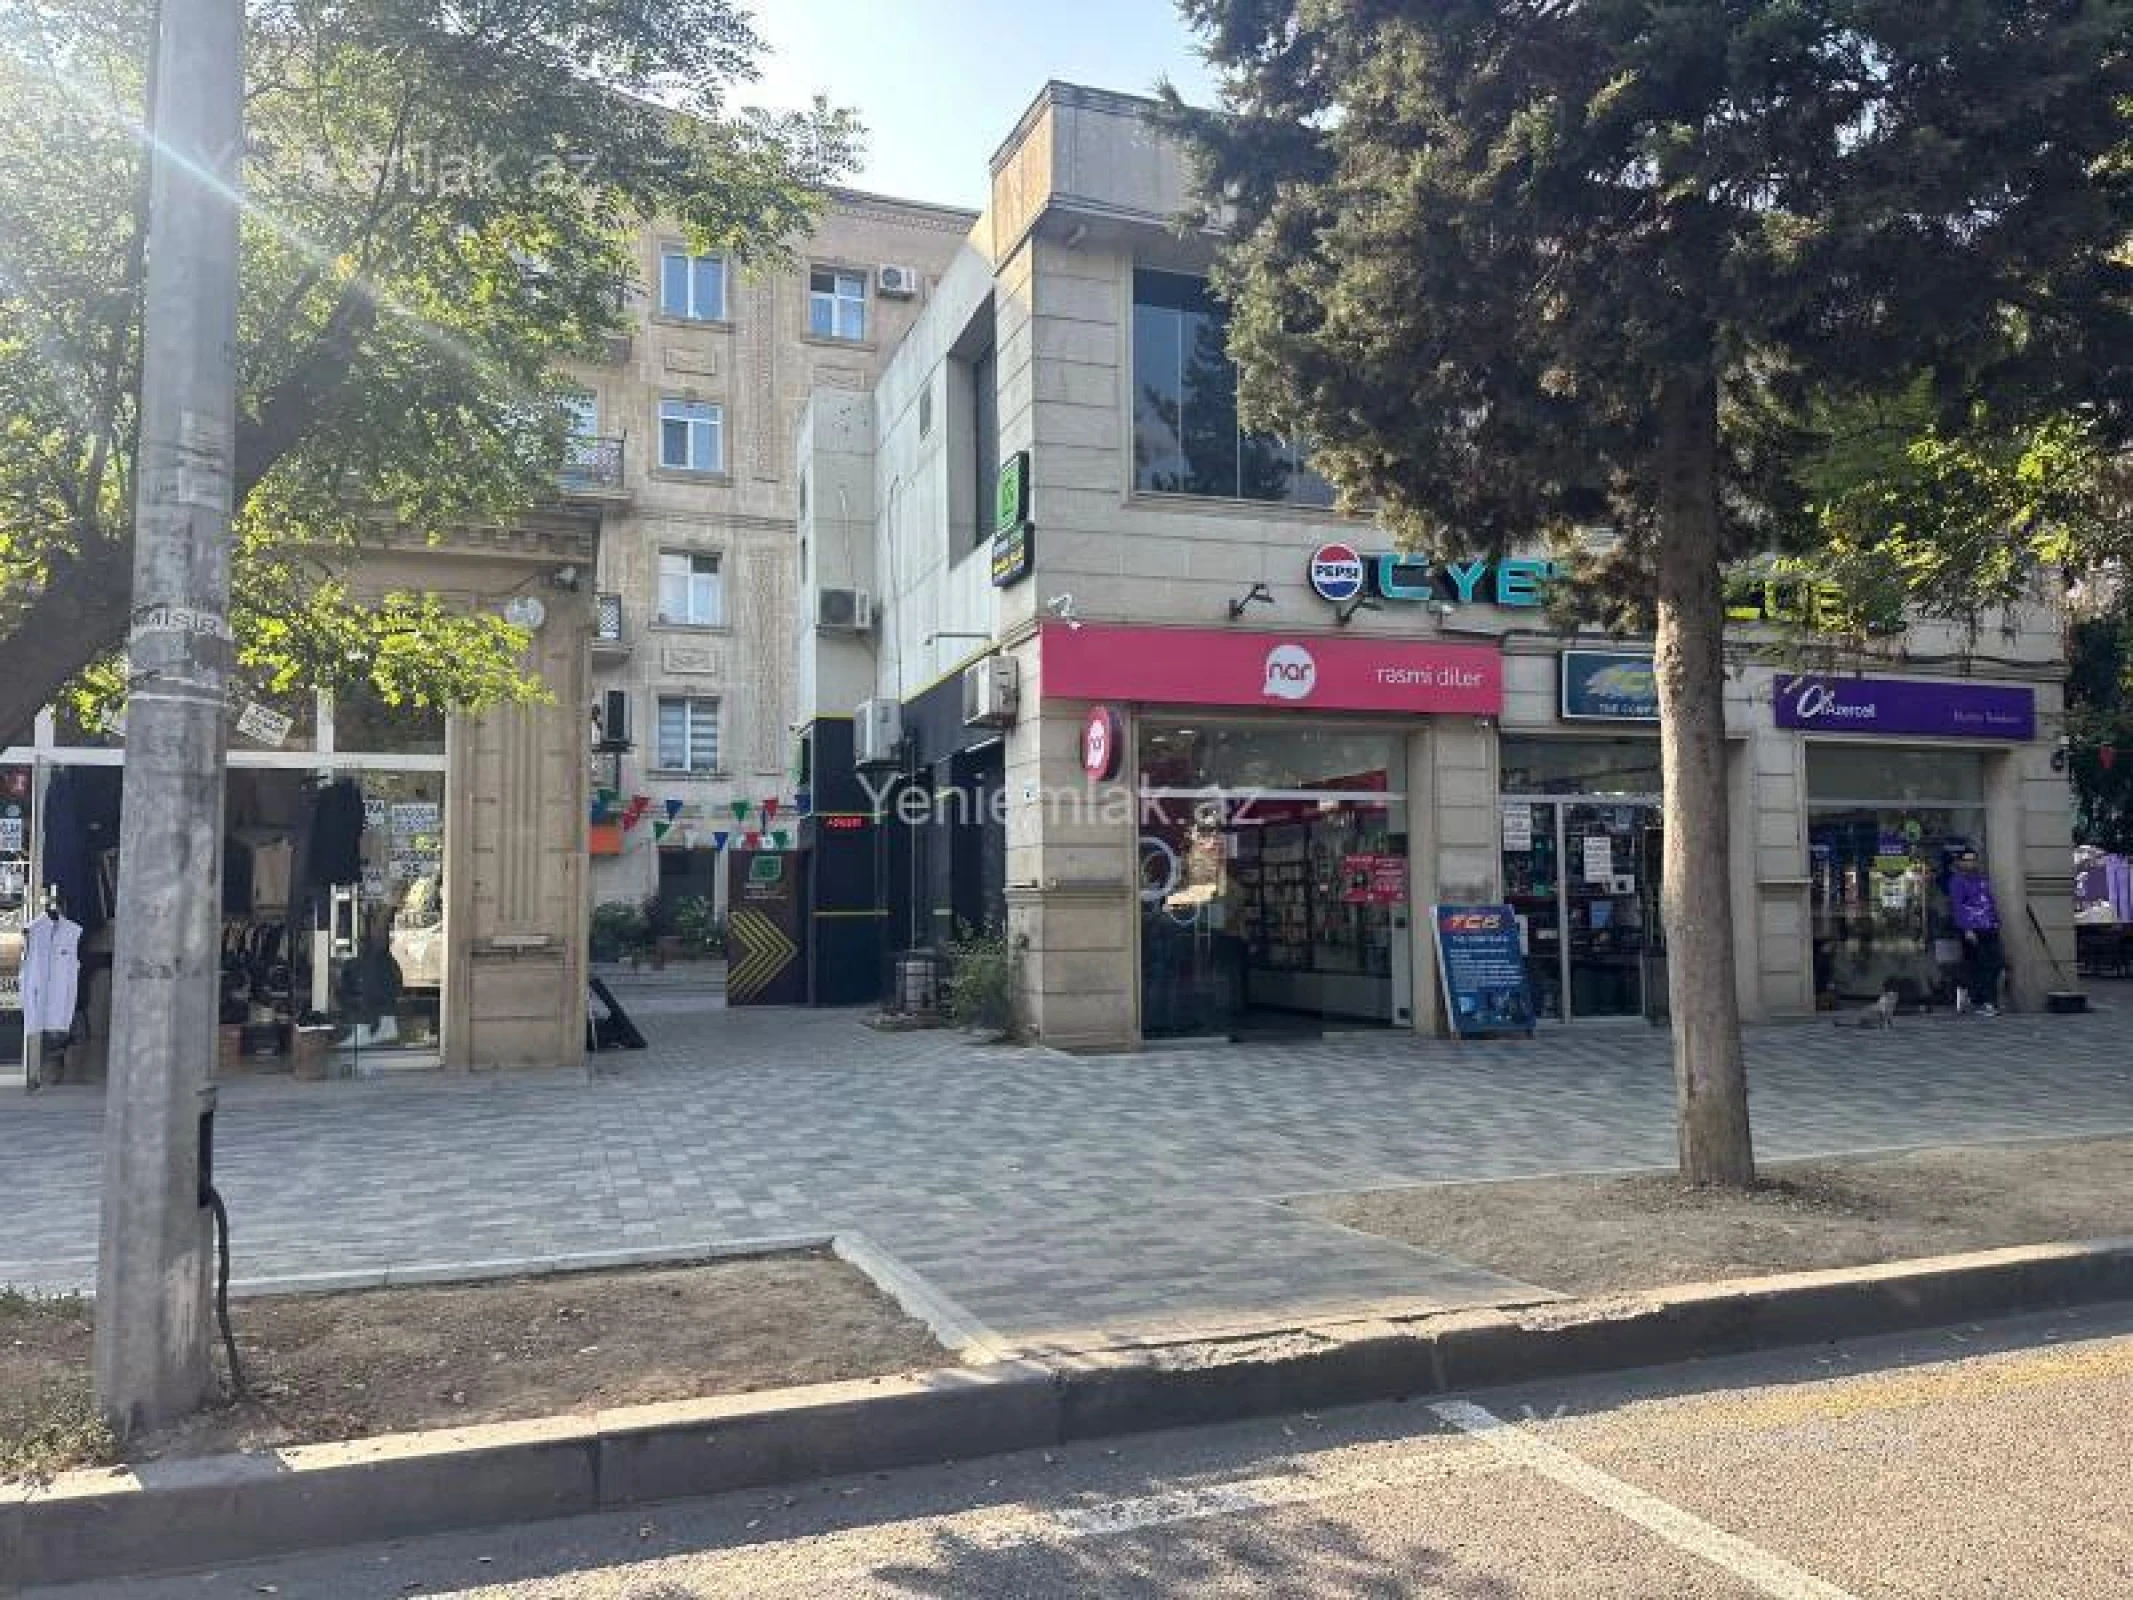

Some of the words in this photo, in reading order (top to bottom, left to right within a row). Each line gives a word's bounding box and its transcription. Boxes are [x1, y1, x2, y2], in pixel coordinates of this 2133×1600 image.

[1314, 564, 1359, 578] PEPSI
[1269, 661, 1311, 681] nar
[1377, 666, 1432, 685] rasmi
[1825, 703, 1877, 719] Azercell
